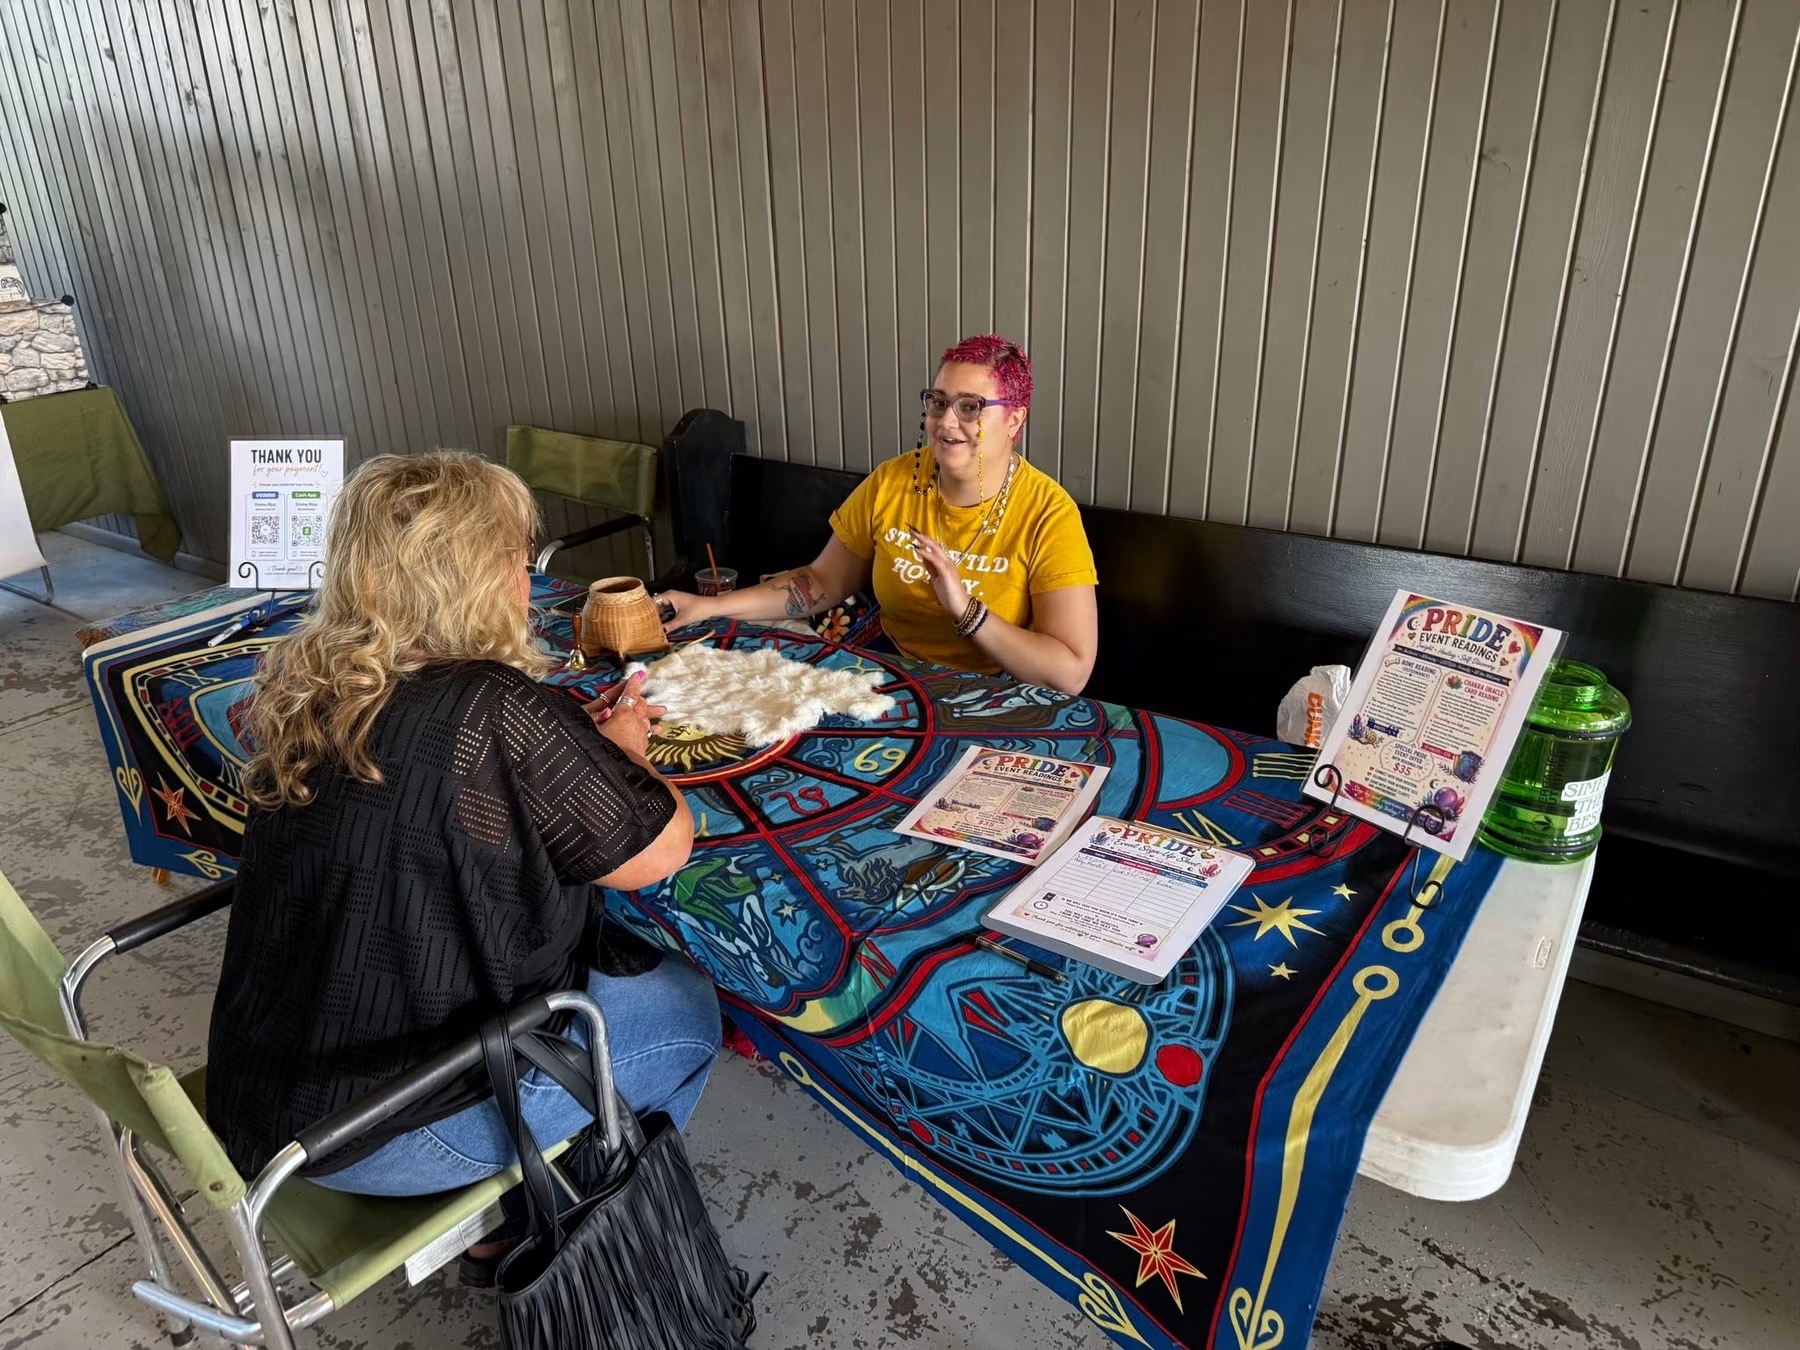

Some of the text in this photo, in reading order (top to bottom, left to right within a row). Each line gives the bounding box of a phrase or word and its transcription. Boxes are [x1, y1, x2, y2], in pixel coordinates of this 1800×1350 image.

[251, 449, 322, 463] THANK YOU
[253, 464, 322, 477] for your payment!
[948, 550, 1009, 573] WILD
[1422, 608, 1512, 652] PRIDE
[1419, 632, 1499, 663] EVENT READINGS
[1400, 659, 1437, 675] BONE READING
[1463, 678, 1505, 697] CHAKRA ORACLE
[1463, 686, 1500, 702] CARD READING
[1393, 742, 1427, 759] SPECIAL PRIDE
[1393, 749, 1423, 764] EVENT OFFER
[994, 766, 1022, 777] EVENT
[1022, 768, 1064, 783] READINGS
[996, 756, 1071, 778] PRIDE
[1392, 761, 1412, 776] $35
[1567, 810, 1598, 832] BES
[1120, 827, 1200, 858] PRIDE
[1112, 838, 1203, 867] Event Sign-Up Sheet
